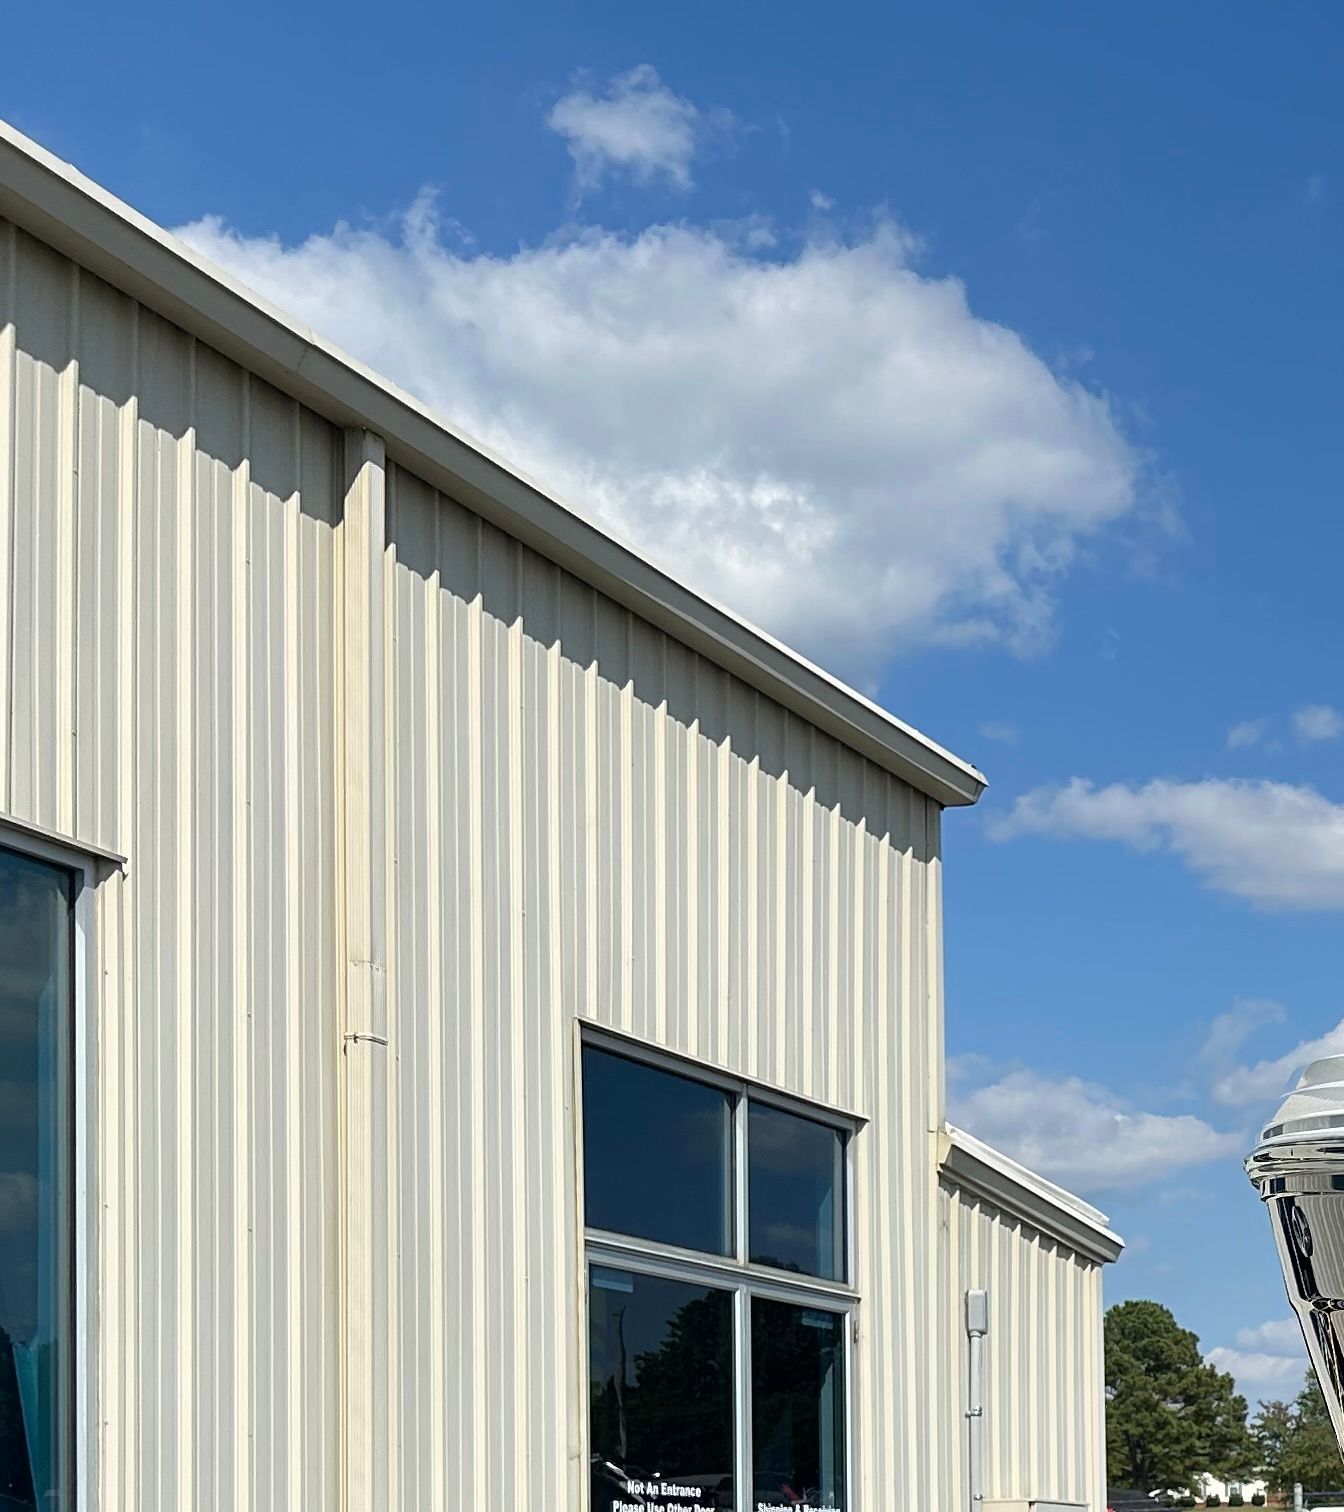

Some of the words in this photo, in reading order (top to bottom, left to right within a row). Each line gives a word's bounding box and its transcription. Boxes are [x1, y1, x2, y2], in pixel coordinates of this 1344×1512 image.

[627, 1480, 644, 1494] Not
[646, 1481, 659, 1495] An
[660, 1482, 702, 1498] Entrance
